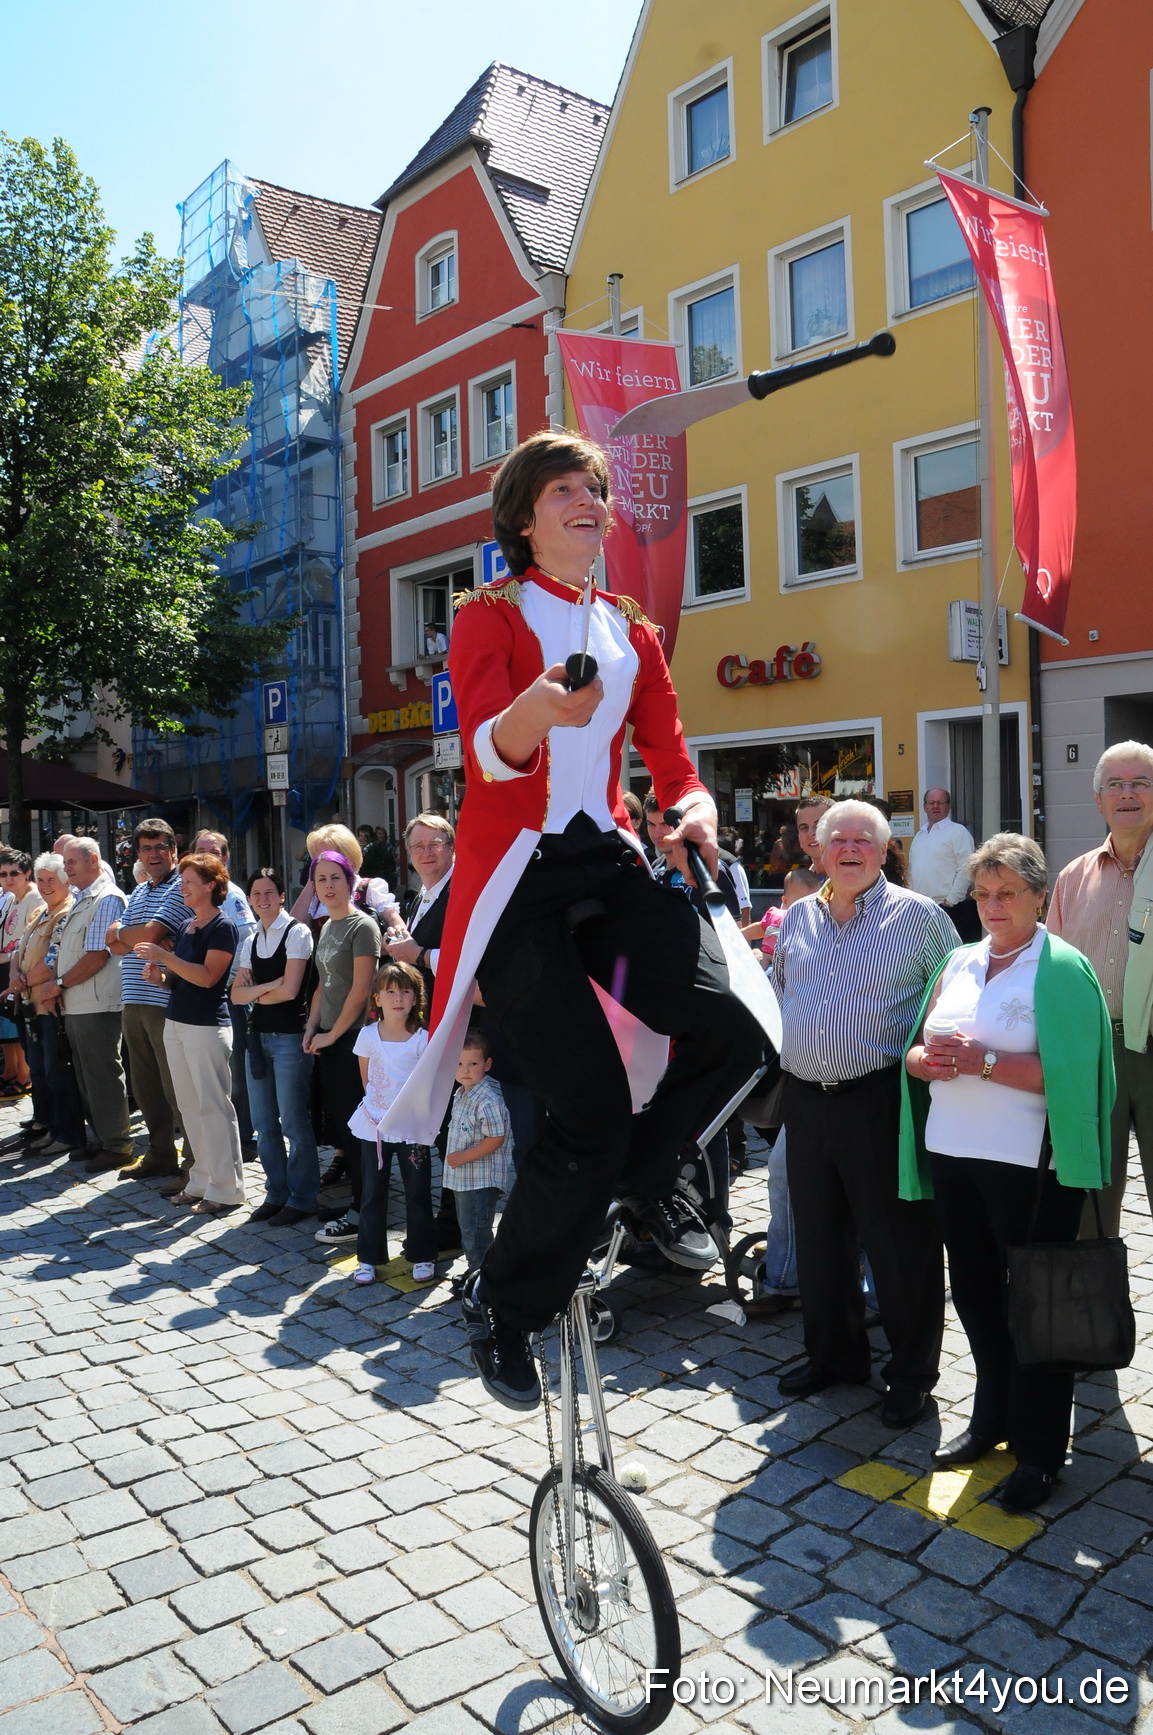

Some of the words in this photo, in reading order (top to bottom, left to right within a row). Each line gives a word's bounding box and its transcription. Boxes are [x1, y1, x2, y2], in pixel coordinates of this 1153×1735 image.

[571, 358, 611, 382] Wir
[615, 366, 677, 391] feiern
[491, 549, 510, 582] P
[717, 641, 820, 689] Café
[269, 688, 282, 720] P
[368, 709, 396, 734] DER
[400, 700, 433, 729] BÄC
[438, 680, 452, 726] P
[898, 743, 905, 756] 5
[1069, 746, 1076, 760] 6
